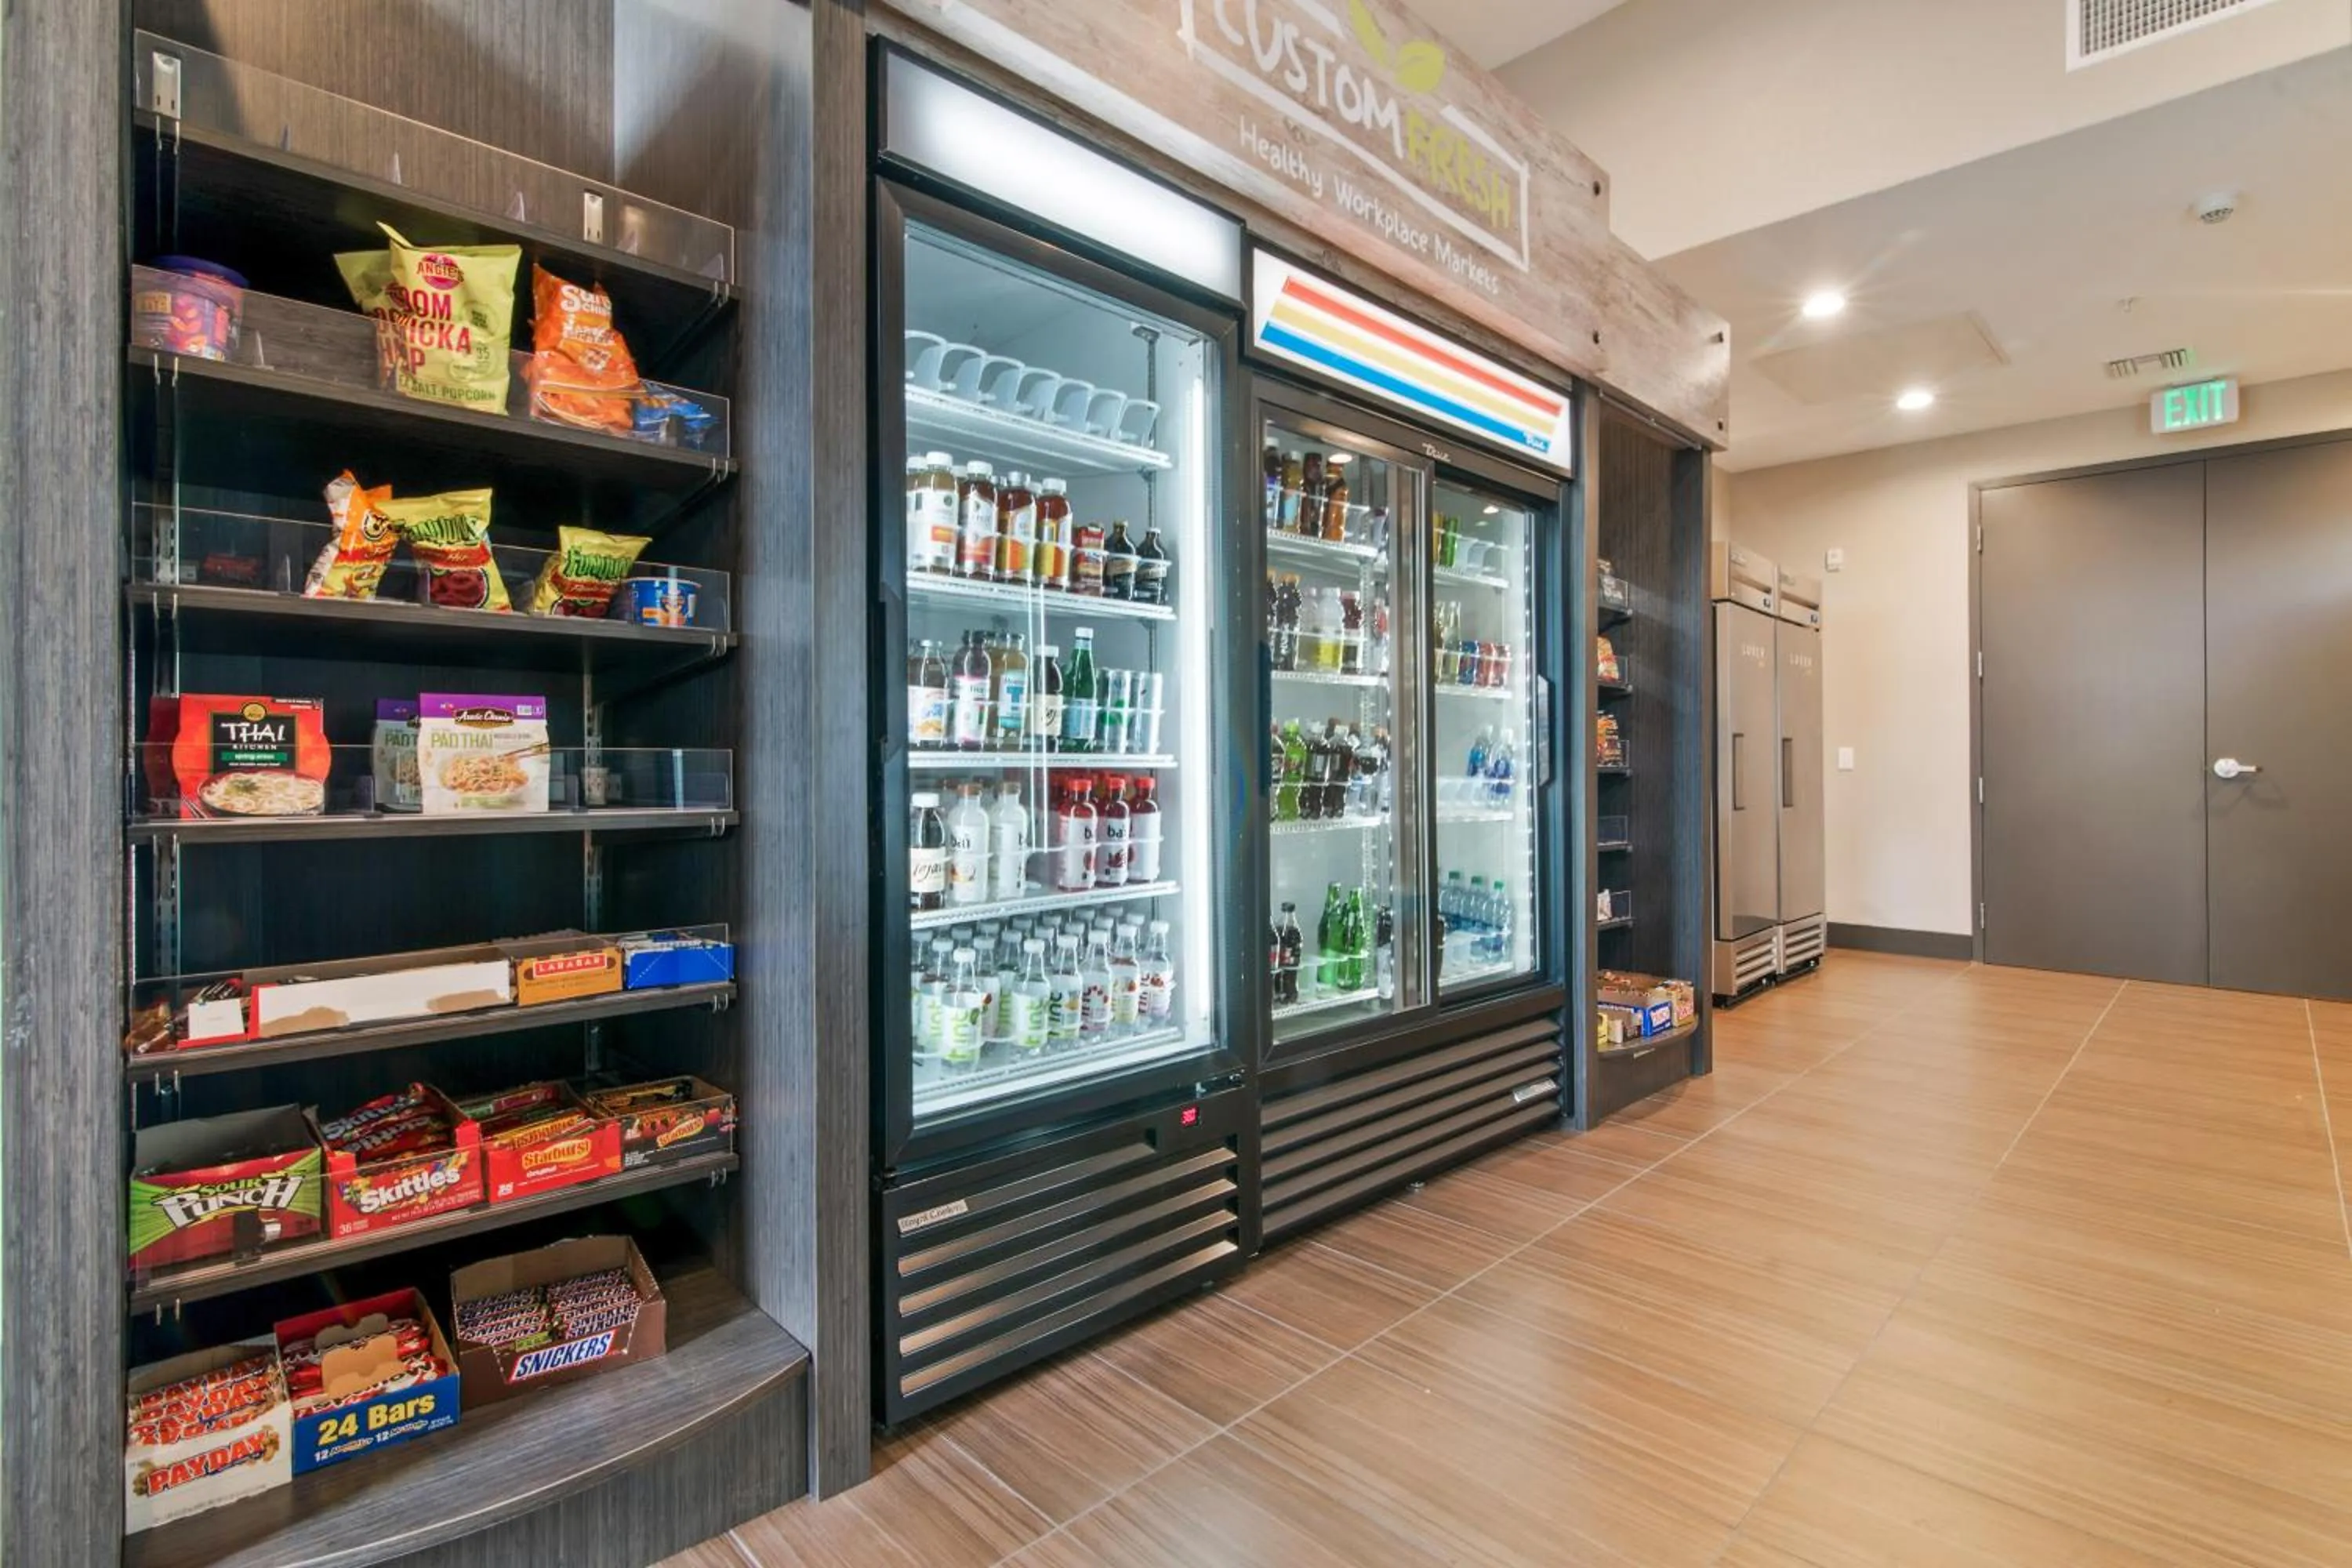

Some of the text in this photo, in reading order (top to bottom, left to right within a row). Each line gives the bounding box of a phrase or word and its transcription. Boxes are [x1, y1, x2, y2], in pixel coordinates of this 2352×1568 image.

[1214, 0, 1511, 229] CUSTOM FRESH
[1240, 115, 1499, 295] Healthy Workplace Markets
[2165, 380, 2226, 427] EXIT
[221, 722, 286, 742] THAI
[431, 731, 494, 748] PAD THAI
[539, 956, 601, 973] LARABAR
[524, 1140, 590, 1168] Starburst
[154, 1176, 304, 1229] PUNCH
[199, 1176, 267, 1194] SOUR
[360, 1167, 461, 1214] Skittles
[517, 1334, 611, 1377] SNICKERS
[318, 1412, 359, 1446] 24
[368, 1394, 436, 1431] Bars
[376, 1430, 390, 1443] 12
[147, 1431, 268, 1497] PAYDAY
